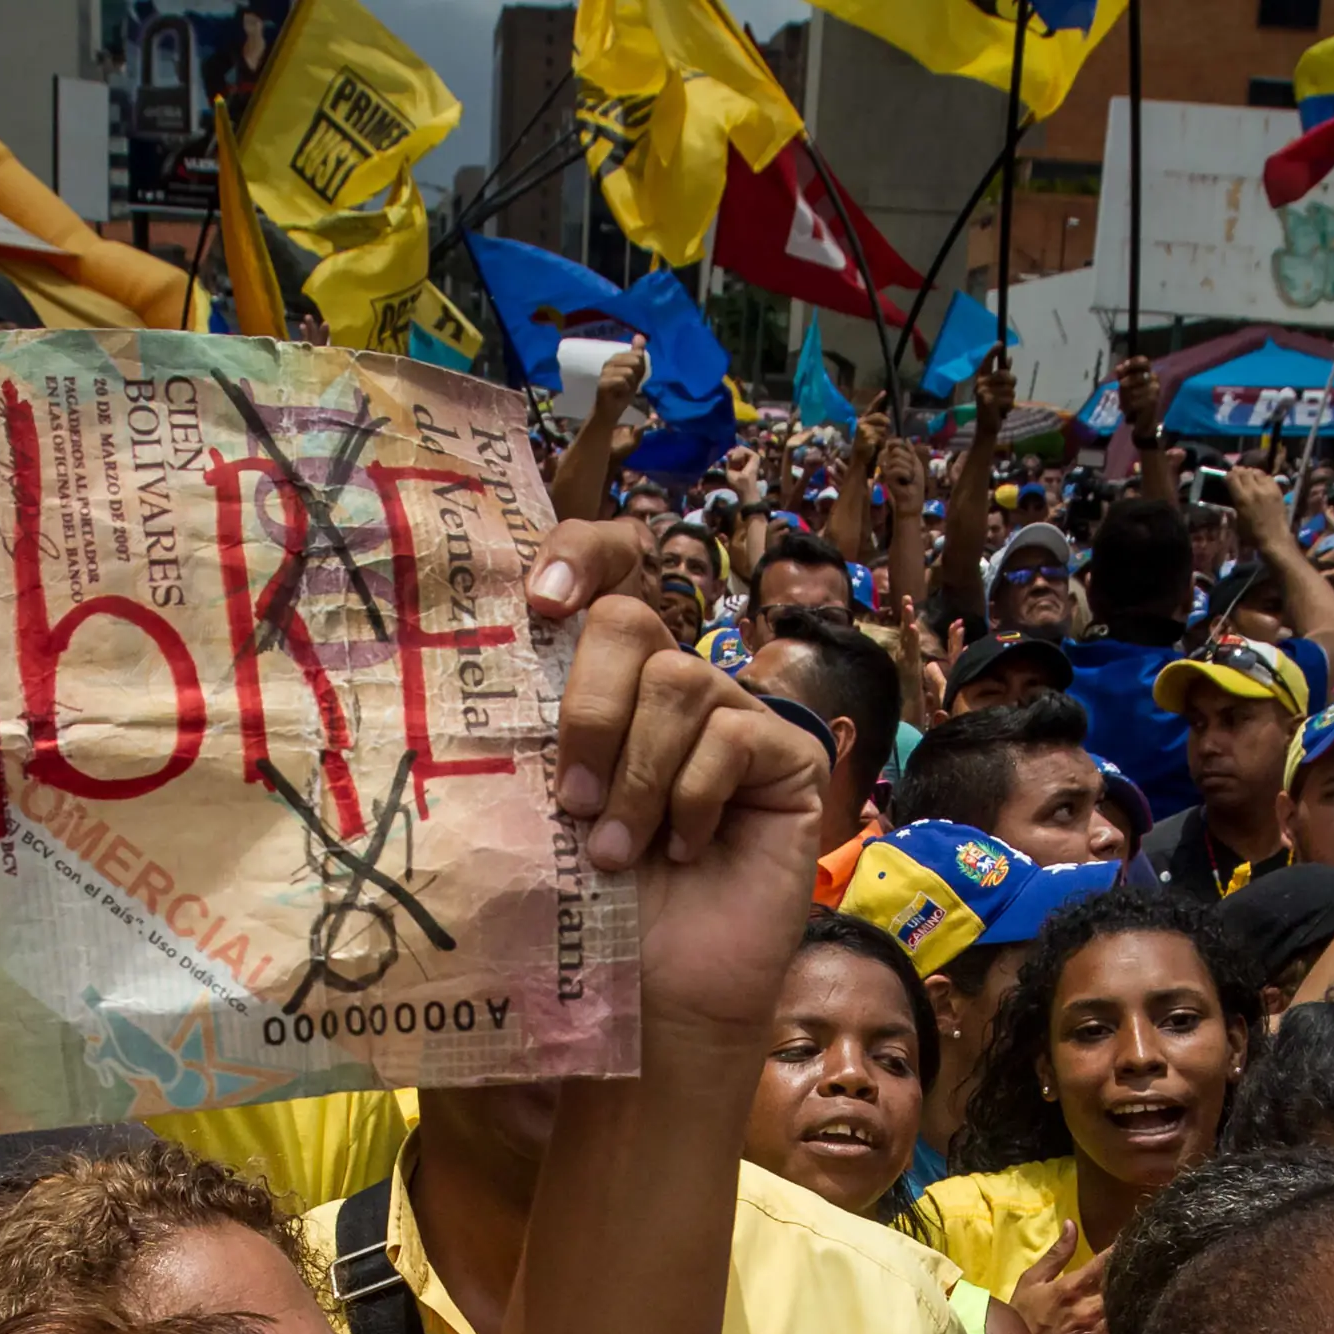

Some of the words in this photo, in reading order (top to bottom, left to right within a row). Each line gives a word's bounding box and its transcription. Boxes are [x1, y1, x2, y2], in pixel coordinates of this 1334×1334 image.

[44, 375, 61, 398] EN
[93, 377, 108, 396] 20
[48, 402, 64, 433] LAS
[63, 376, 85, 469] PAGADEROS
[96, 401, 112, 425] DE
[164, 375, 207, 474] CIEN
[412, 403, 461, 455] de
[74, 471, 89, 493] AL
[100, 432, 121, 495] MARZO
[109, 499, 127, 523] DE
[123, 376, 187, 608] BOLÍVARES
[61, 511, 77, 541] DEL
[78, 496, 101, 584] PORTADOR
[113, 526, 131, 563] 2007
[65, 543, 85, 604] BANCO
[431, 477, 519, 734] Venezuela
[0, 840, 18, 878] BCV
[21, 830, 56, 860] BCV
[54, 857, 83, 886] con
[83, 877, 103, 899] el
[147, 928, 178, 959] Uso
[907, 913, 927, 929] UN
[908, 908, 944, 947] CAMINO
